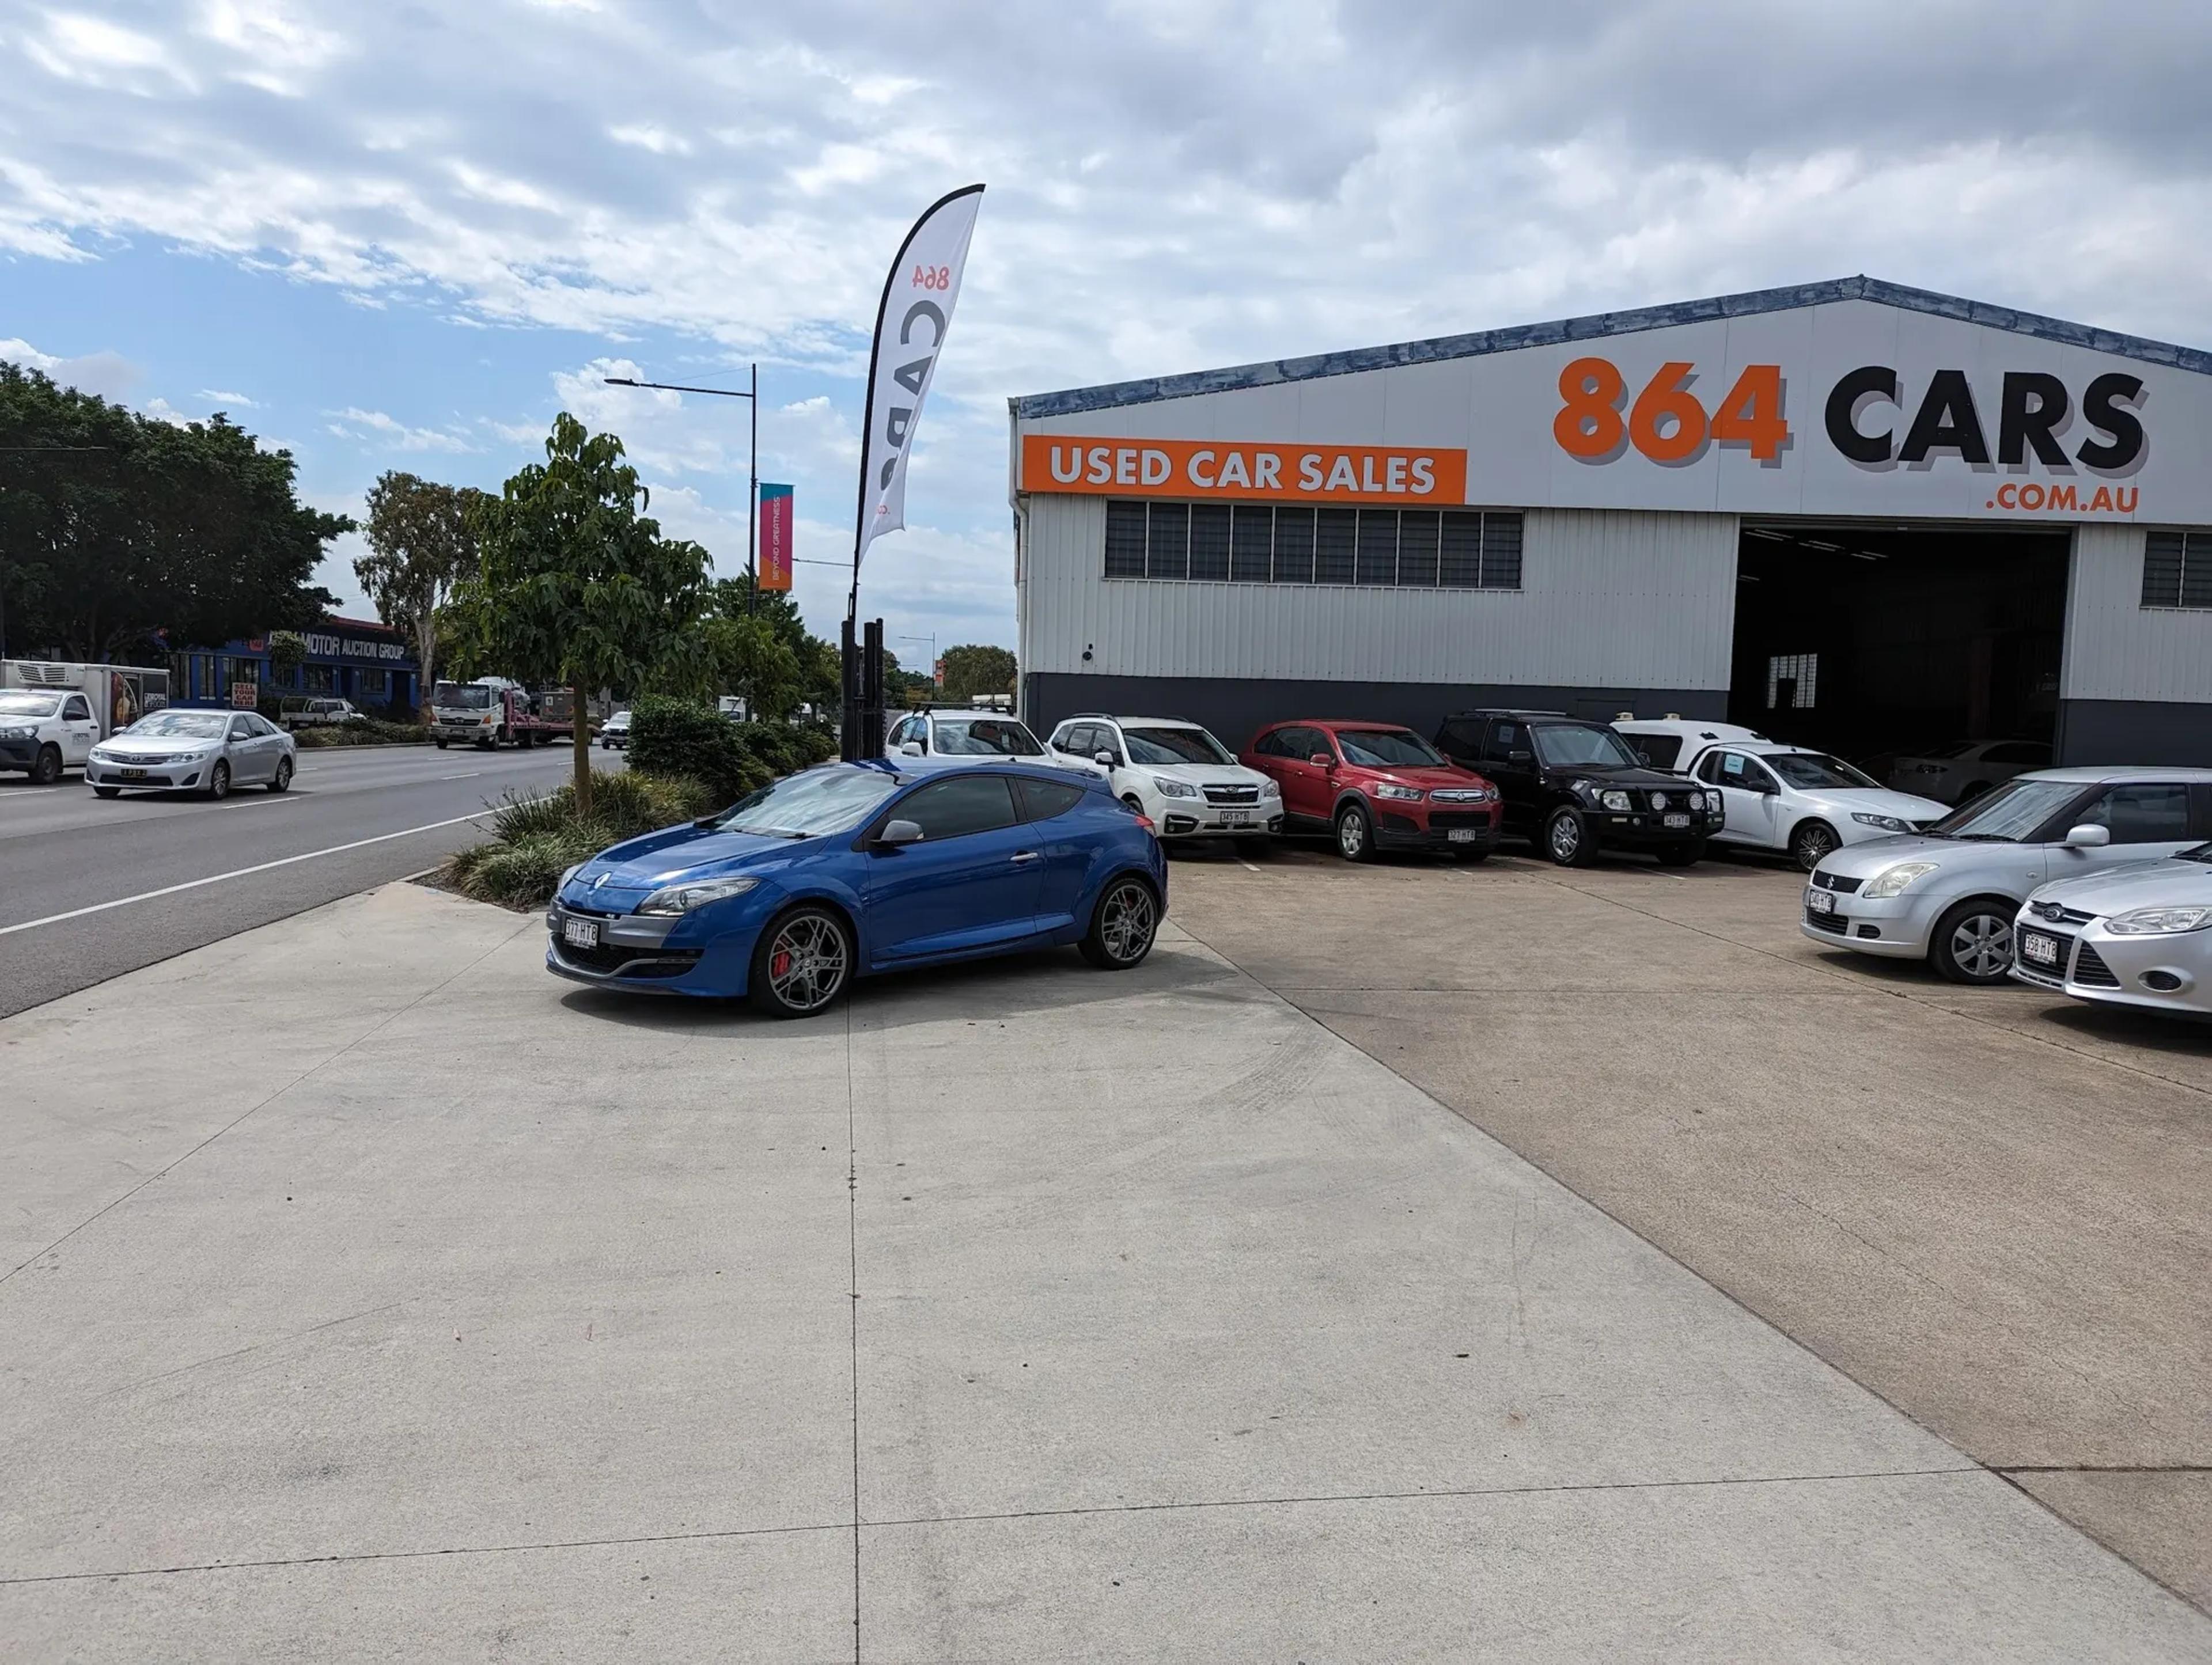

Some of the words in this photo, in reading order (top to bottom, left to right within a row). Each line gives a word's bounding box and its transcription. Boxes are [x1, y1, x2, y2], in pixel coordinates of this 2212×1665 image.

[1553, 358, 1789, 462] 864
[1825, 366, 2145, 470] CARS
[1051, 446, 1171, 486] USED
[1187, 452, 1282, 489] CAR
[1298, 454, 1435, 494] SALES
[1986, 483, 2138, 512] .COM.AU
[342, 639, 377, 658] AUCTION
[378, 643, 404, 661] GROUP
